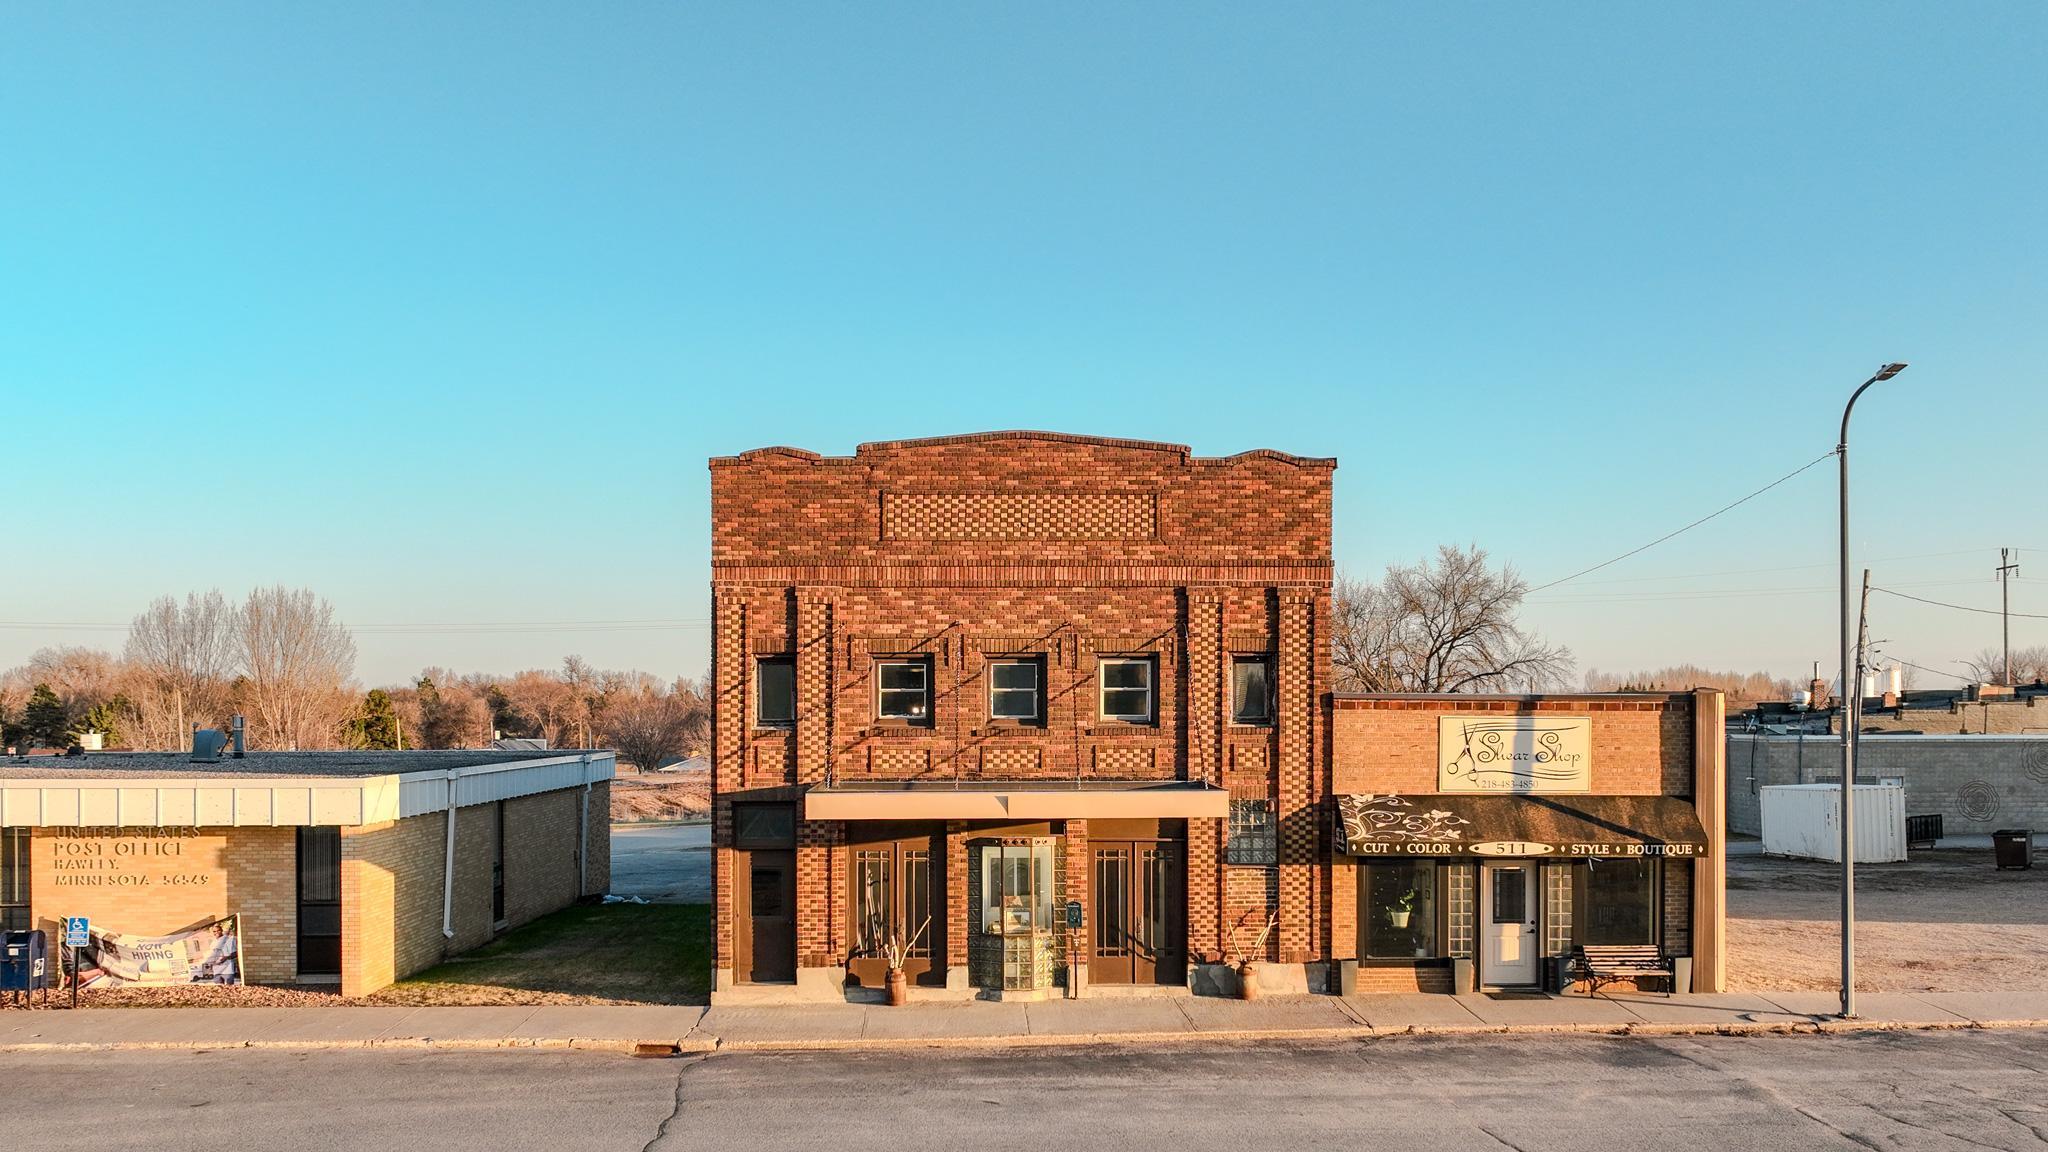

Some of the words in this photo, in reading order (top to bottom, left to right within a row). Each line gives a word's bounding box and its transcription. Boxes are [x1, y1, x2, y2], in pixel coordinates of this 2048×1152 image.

[1477, 732, 1530, 764] Shear
[1535, 732, 1581, 767] Shop
[1481, 780, 1539, 789] 218-483-4850
[56, 826, 125, 838] UNITED
[135, 826, 201, 838] STATES
[54, 842, 103, 856] POST
[114, 842, 182, 856] OFFICE
[1362, 843, 1390, 854] CUT
[1406, 843, 1452, 854] COLOR
[1495, 843, 1527, 854] 511
[1571, 844, 1610, 855] STYLE
[1627, 844, 1693, 855] BOUTIQUE
[55, 875, 150, 886] MINNESOTA
[163, 875, 209, 885] 56549
[131, 950, 174, 960] HIRING
